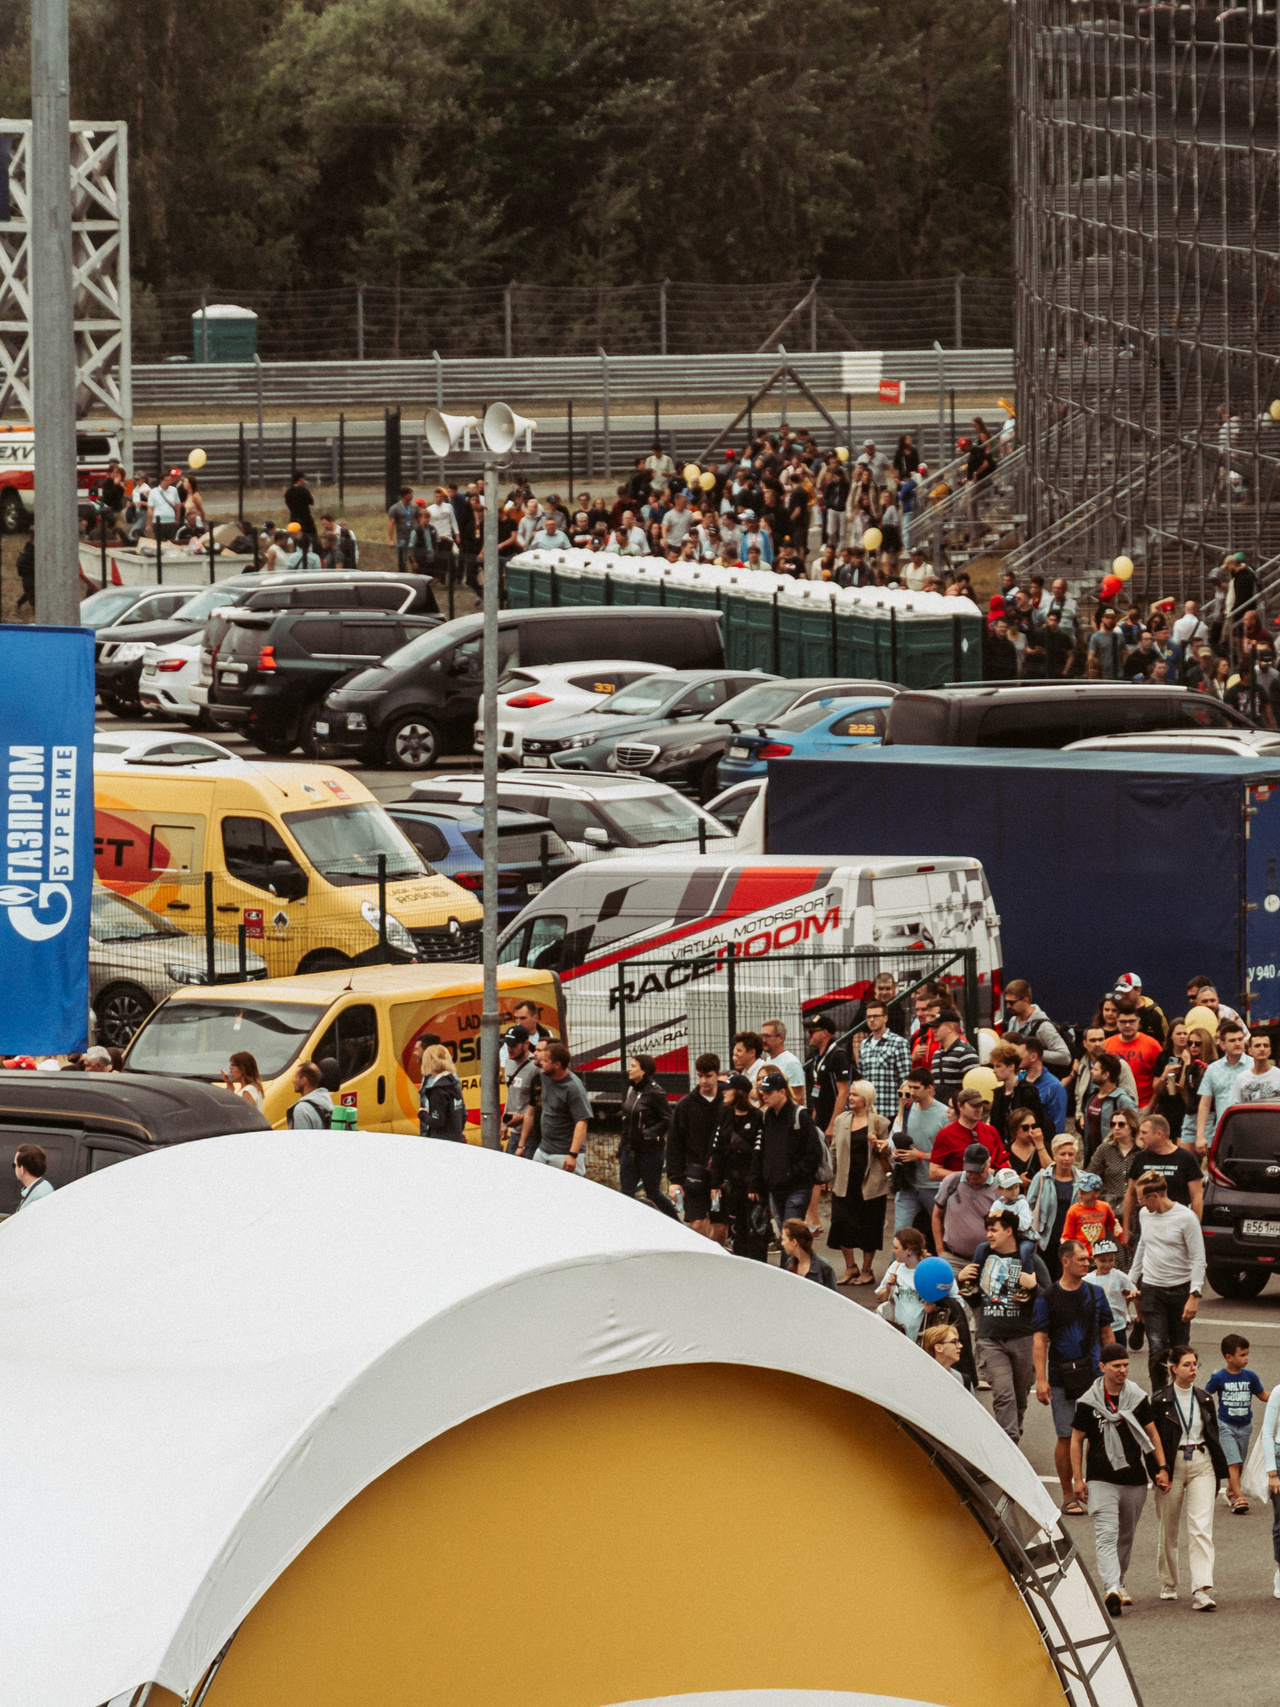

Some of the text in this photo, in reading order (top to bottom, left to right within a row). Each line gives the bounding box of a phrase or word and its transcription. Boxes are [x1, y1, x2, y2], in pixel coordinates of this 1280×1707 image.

[594, 682, 616, 694] 331
[848, 723, 876, 735] 222
[7, 745, 45, 881] ГАЗПРОМ
[53, 750, 73, 876] БУРЕНИЕ
[671, 893, 834, 960] VIRTUAL MOTORSPORT
